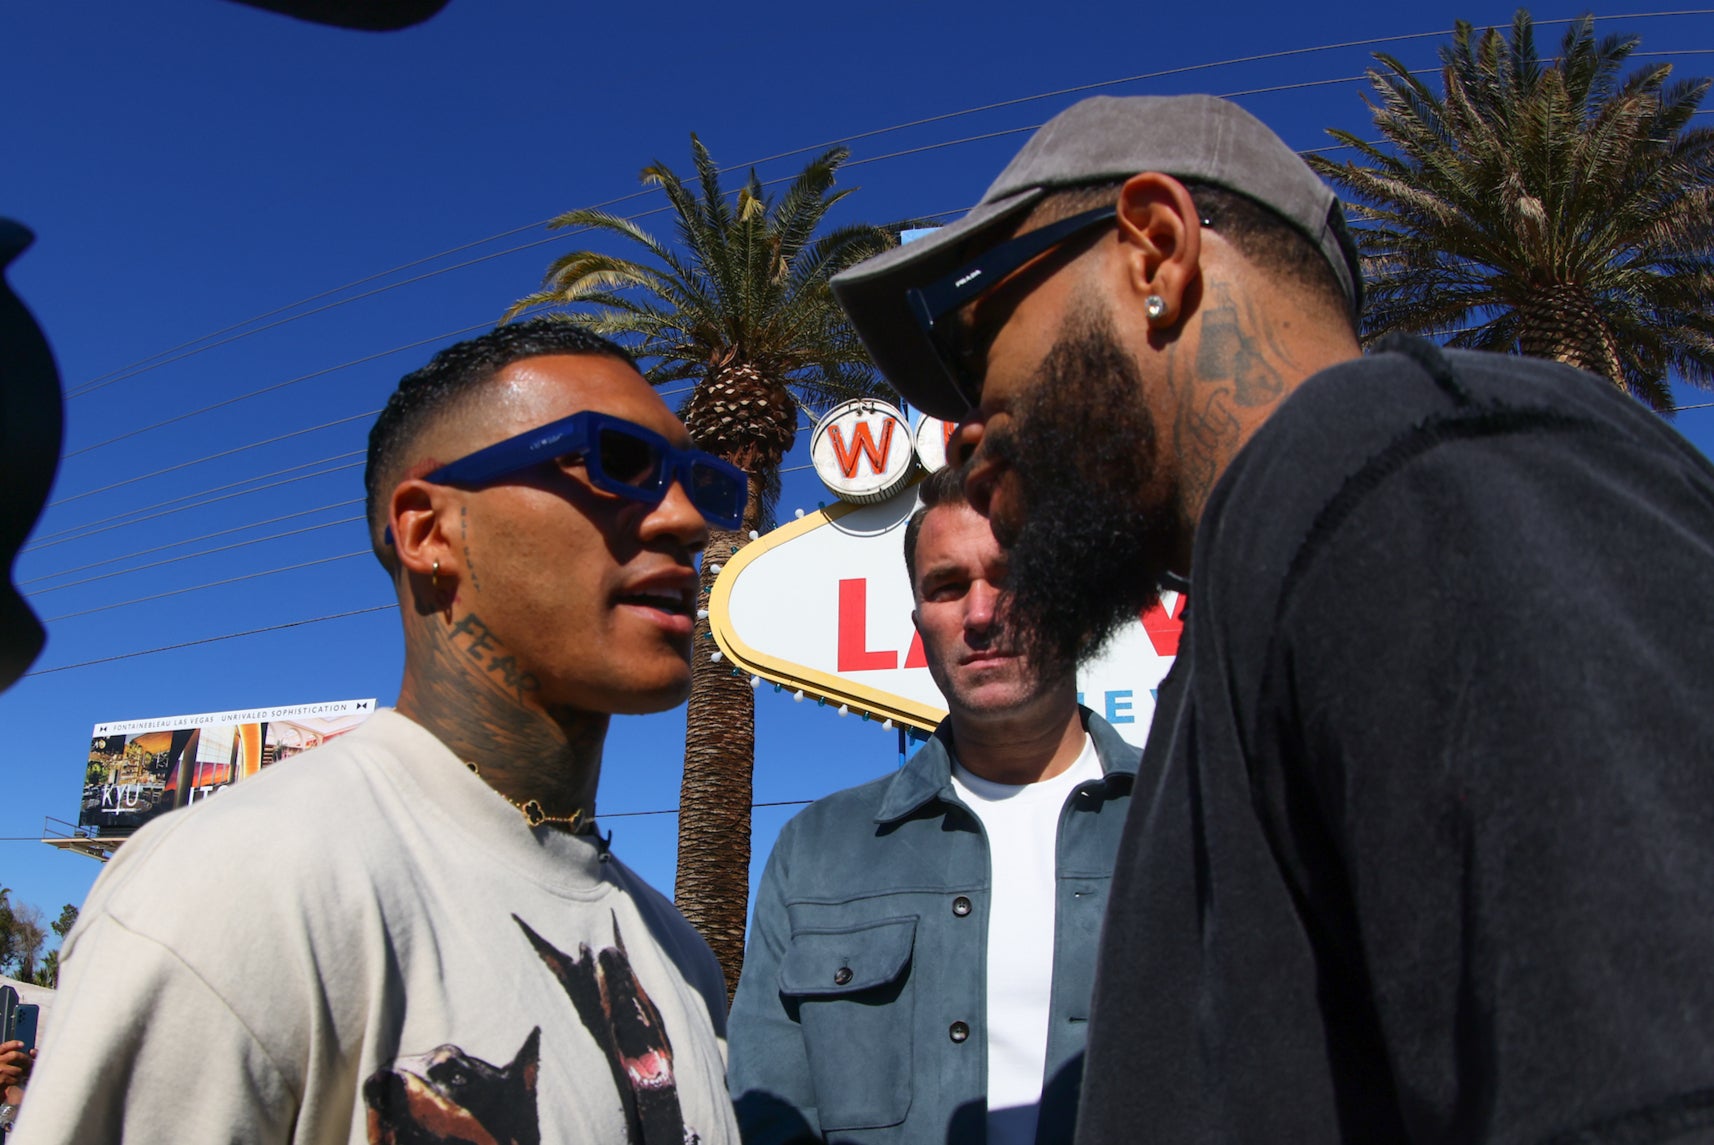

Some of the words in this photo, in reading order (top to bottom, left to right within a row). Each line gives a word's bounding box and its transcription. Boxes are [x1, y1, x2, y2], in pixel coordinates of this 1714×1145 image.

[838, 578, 928, 672] L
[448, 611, 541, 702] FEAR
[113, 719, 171, 732] FONTAINEBLEAU
[173, 718, 187, 727] LAS
[190, 716, 214, 725] VEGAS
[221, 711, 267, 722] UNRIVALED
[271, 703, 347, 718] SOPHISTICATION
[101, 783, 141, 815] KYU
[188, 786, 230, 807] IT
